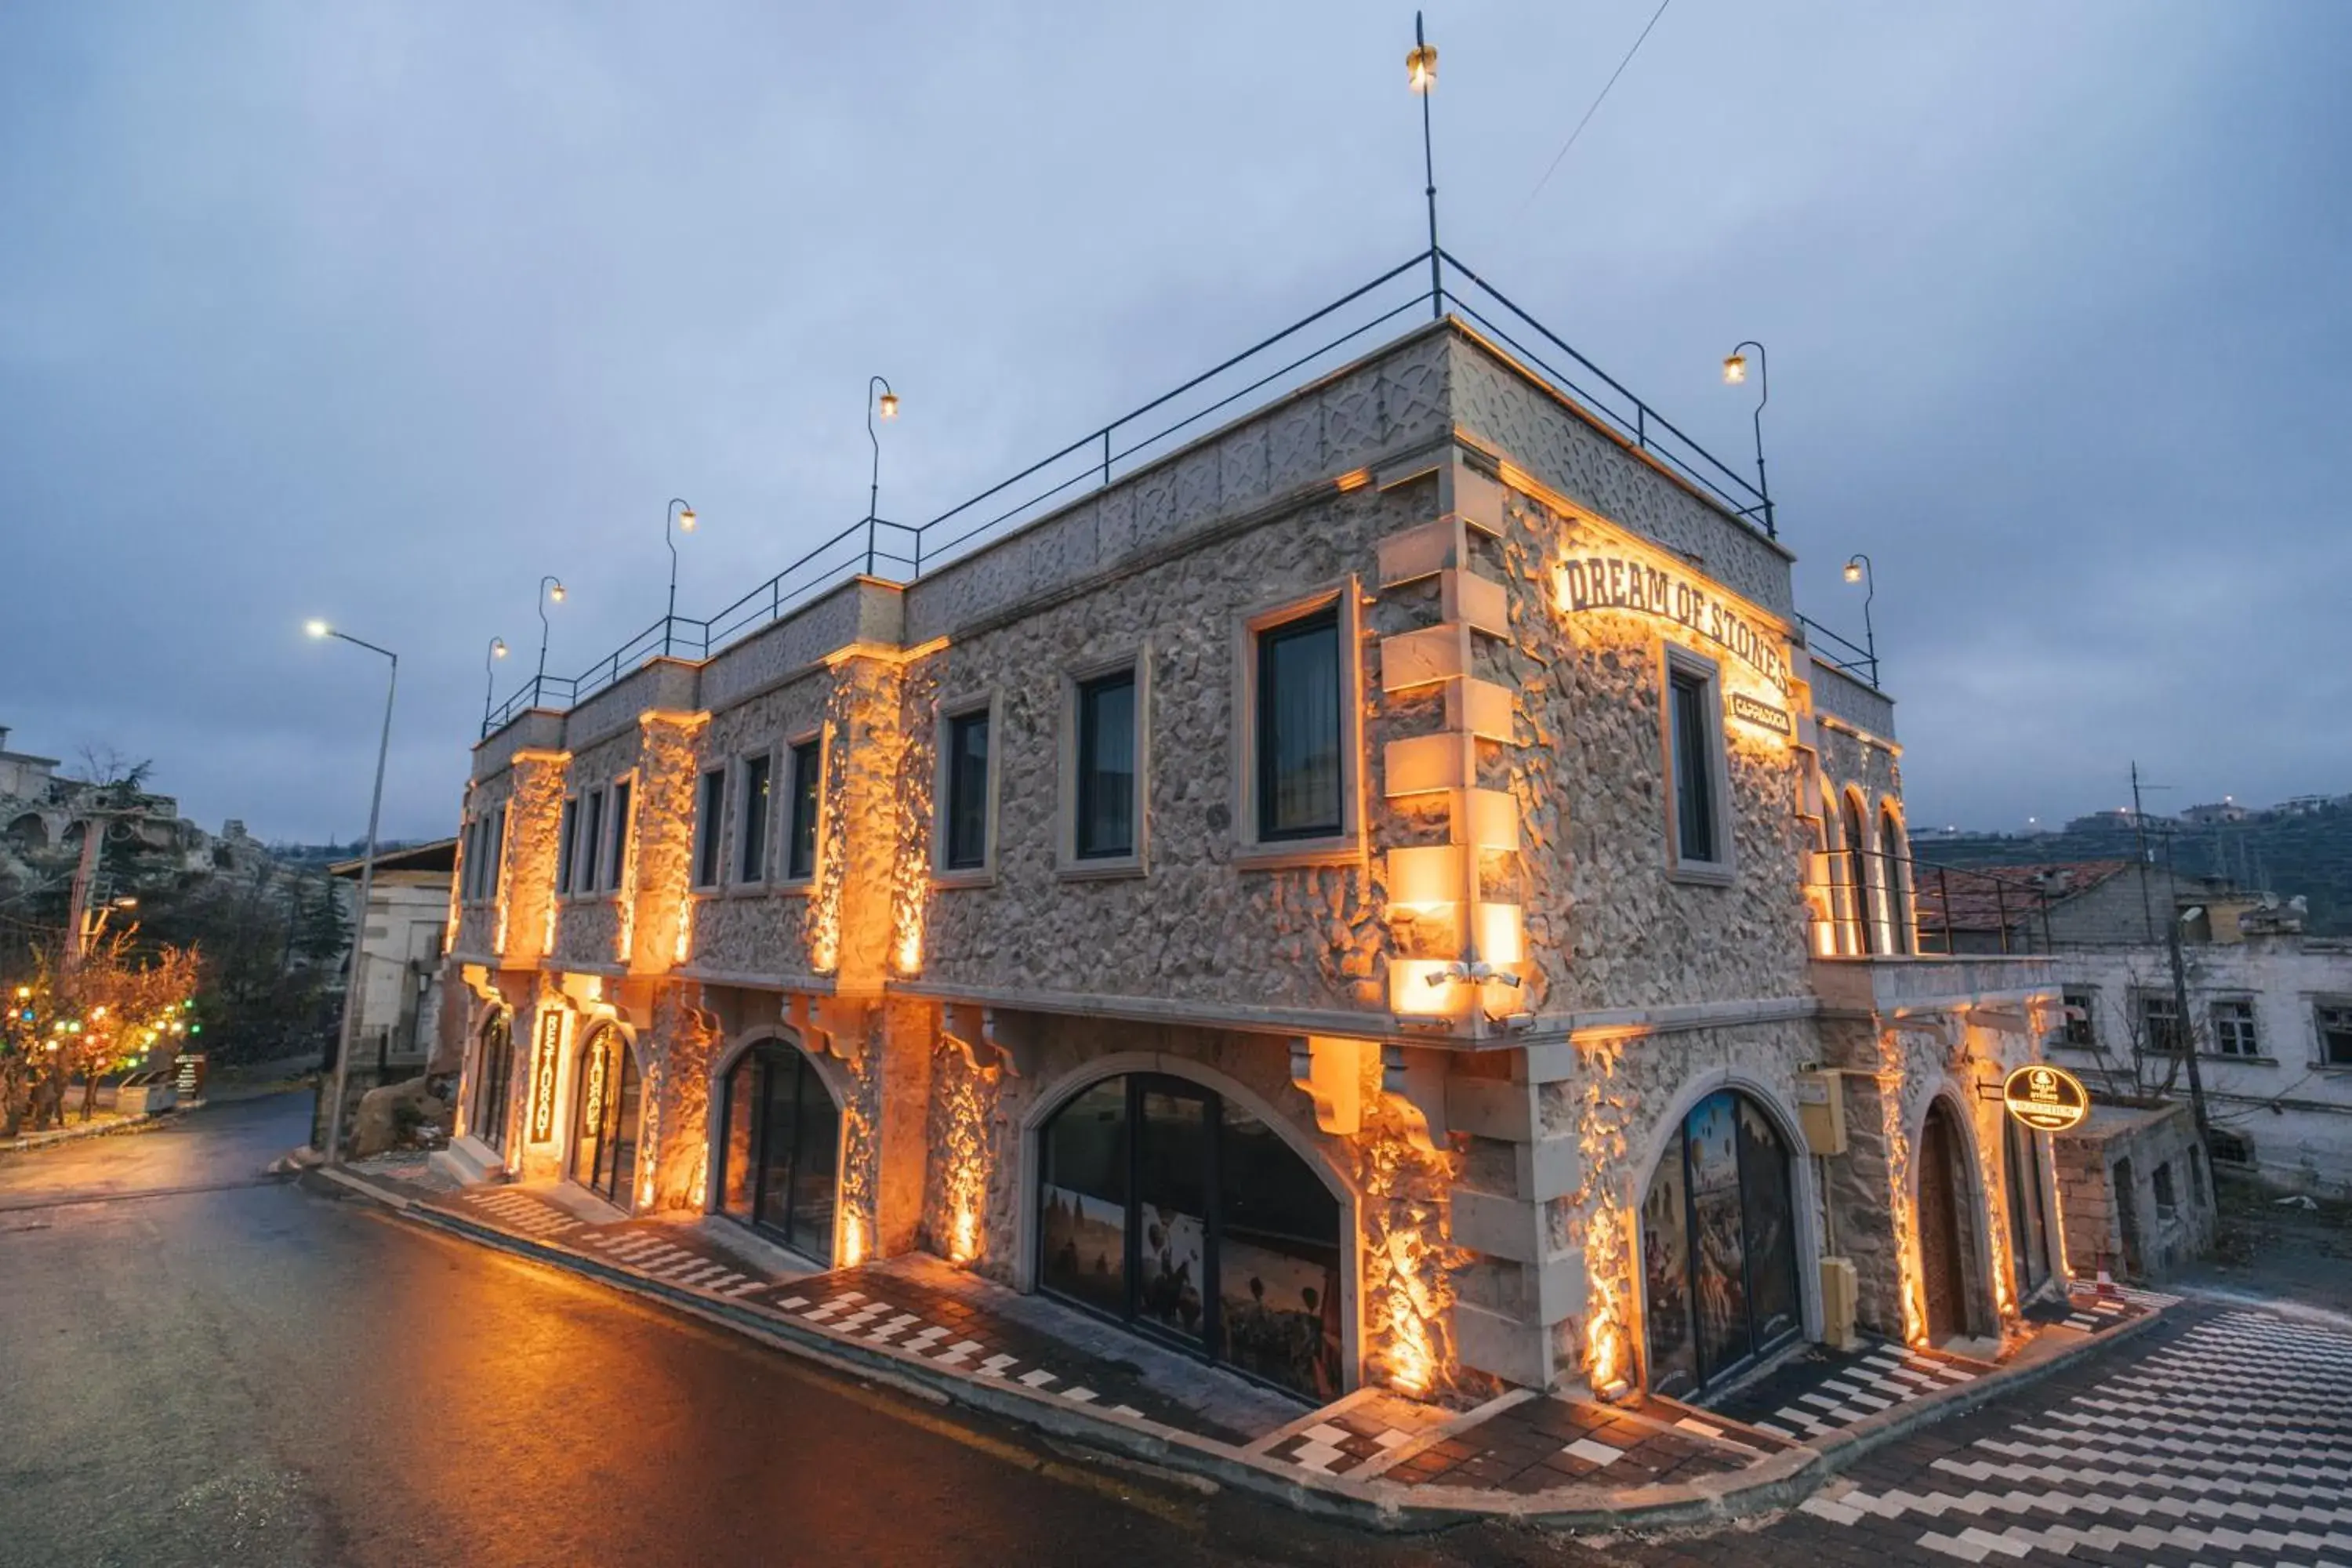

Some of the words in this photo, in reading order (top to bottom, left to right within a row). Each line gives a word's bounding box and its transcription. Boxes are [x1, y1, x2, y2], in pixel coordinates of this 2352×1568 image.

[1565, 557, 1670, 617] DREAM
[1677, 582, 1704, 629] OF
[1711, 602, 1788, 698] STONES
